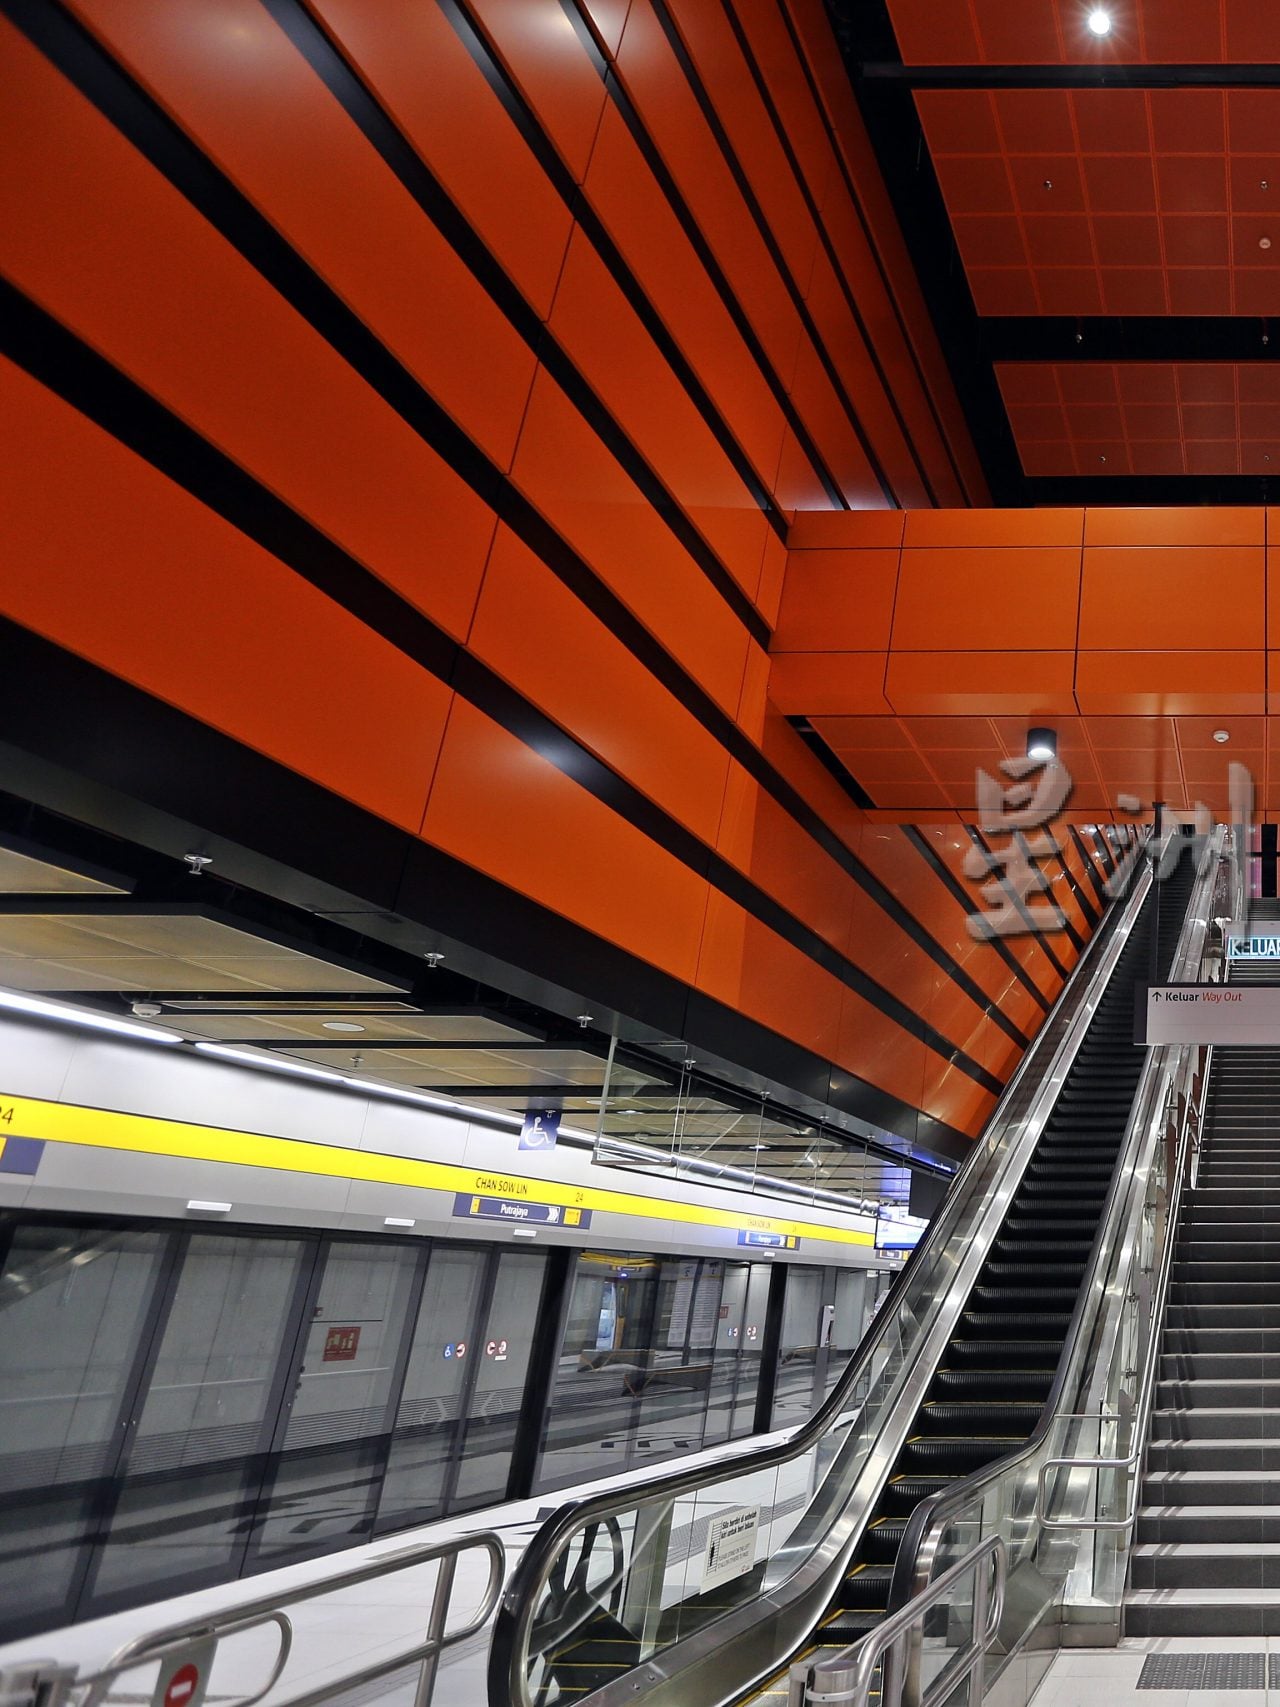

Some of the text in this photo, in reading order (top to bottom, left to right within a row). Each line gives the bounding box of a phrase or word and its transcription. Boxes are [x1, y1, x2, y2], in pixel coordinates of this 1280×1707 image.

[1165, 991, 1242, 1004] Keluar Way Out
[475, 1177, 497, 1191] CHAN
[498, 1180, 515, 1193] SOW
[516, 1183, 528, 1195] LIN
[500, 1204, 529, 1218] Putrajaya
